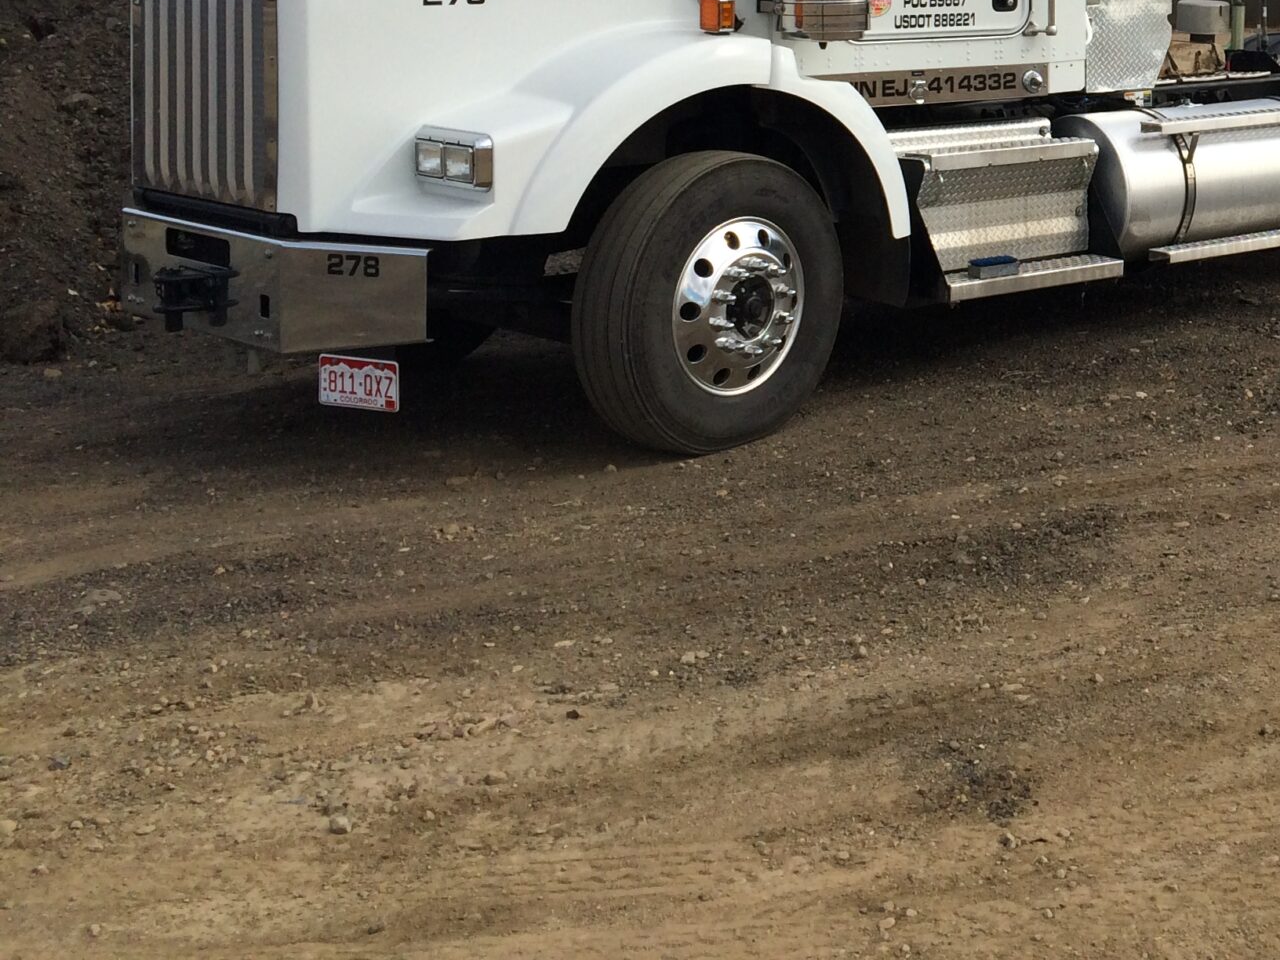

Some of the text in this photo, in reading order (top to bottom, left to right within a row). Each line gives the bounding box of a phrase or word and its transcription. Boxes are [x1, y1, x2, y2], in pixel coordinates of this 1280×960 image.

[894, 12, 976, 29] USDOT 888221
[327, 253, 380, 278] 278
[339, 395, 378, 406] COLORADO
